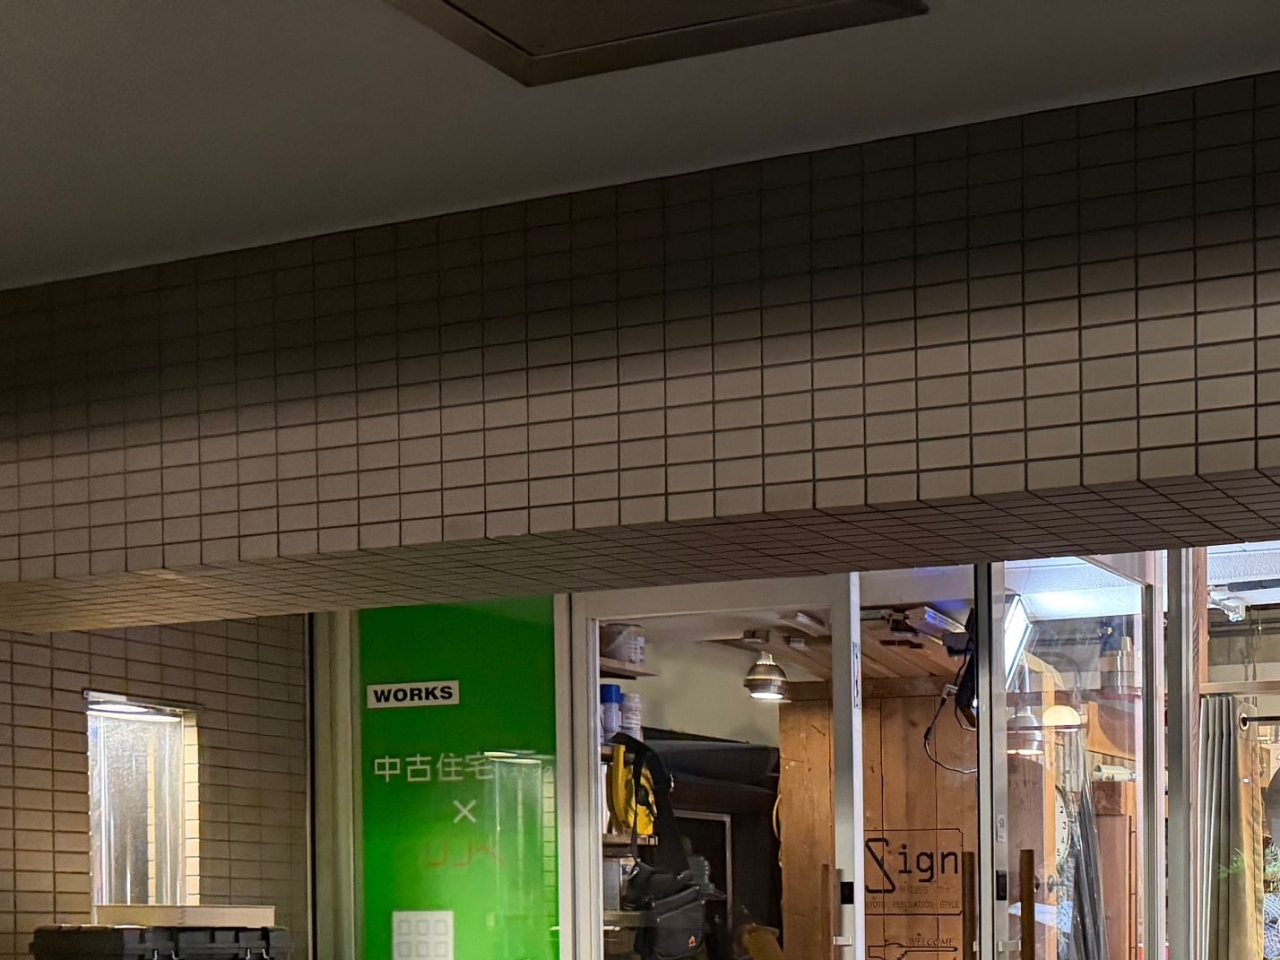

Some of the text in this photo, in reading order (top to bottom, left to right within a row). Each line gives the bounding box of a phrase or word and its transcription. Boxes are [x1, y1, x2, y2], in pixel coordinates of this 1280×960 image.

[373, 686, 453, 703] WORKS
[374, 751, 540, 783] 中古住宅
[865, 837, 959, 893] Sign
